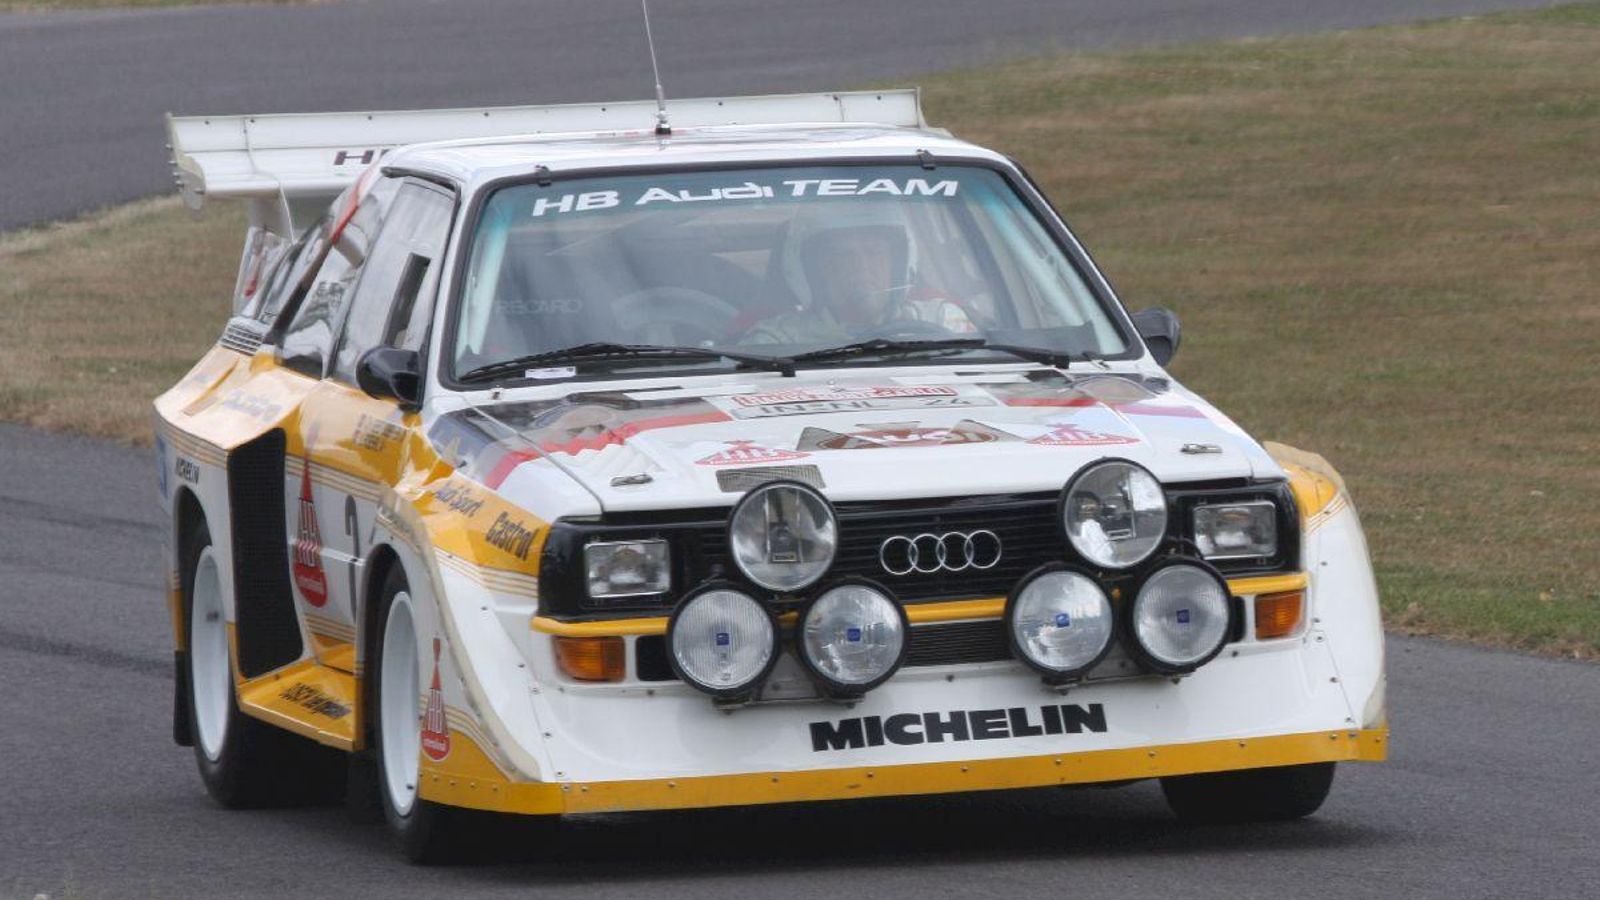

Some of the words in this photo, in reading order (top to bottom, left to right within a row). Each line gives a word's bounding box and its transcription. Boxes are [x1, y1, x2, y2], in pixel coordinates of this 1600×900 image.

[532, 190, 620, 217] HB
[634, 182, 774, 206] Audi
[783, 178, 959, 198] TEAM
[485, 511, 540, 561] Castrol
[809, 703, 1108, 752] MICHELIN
